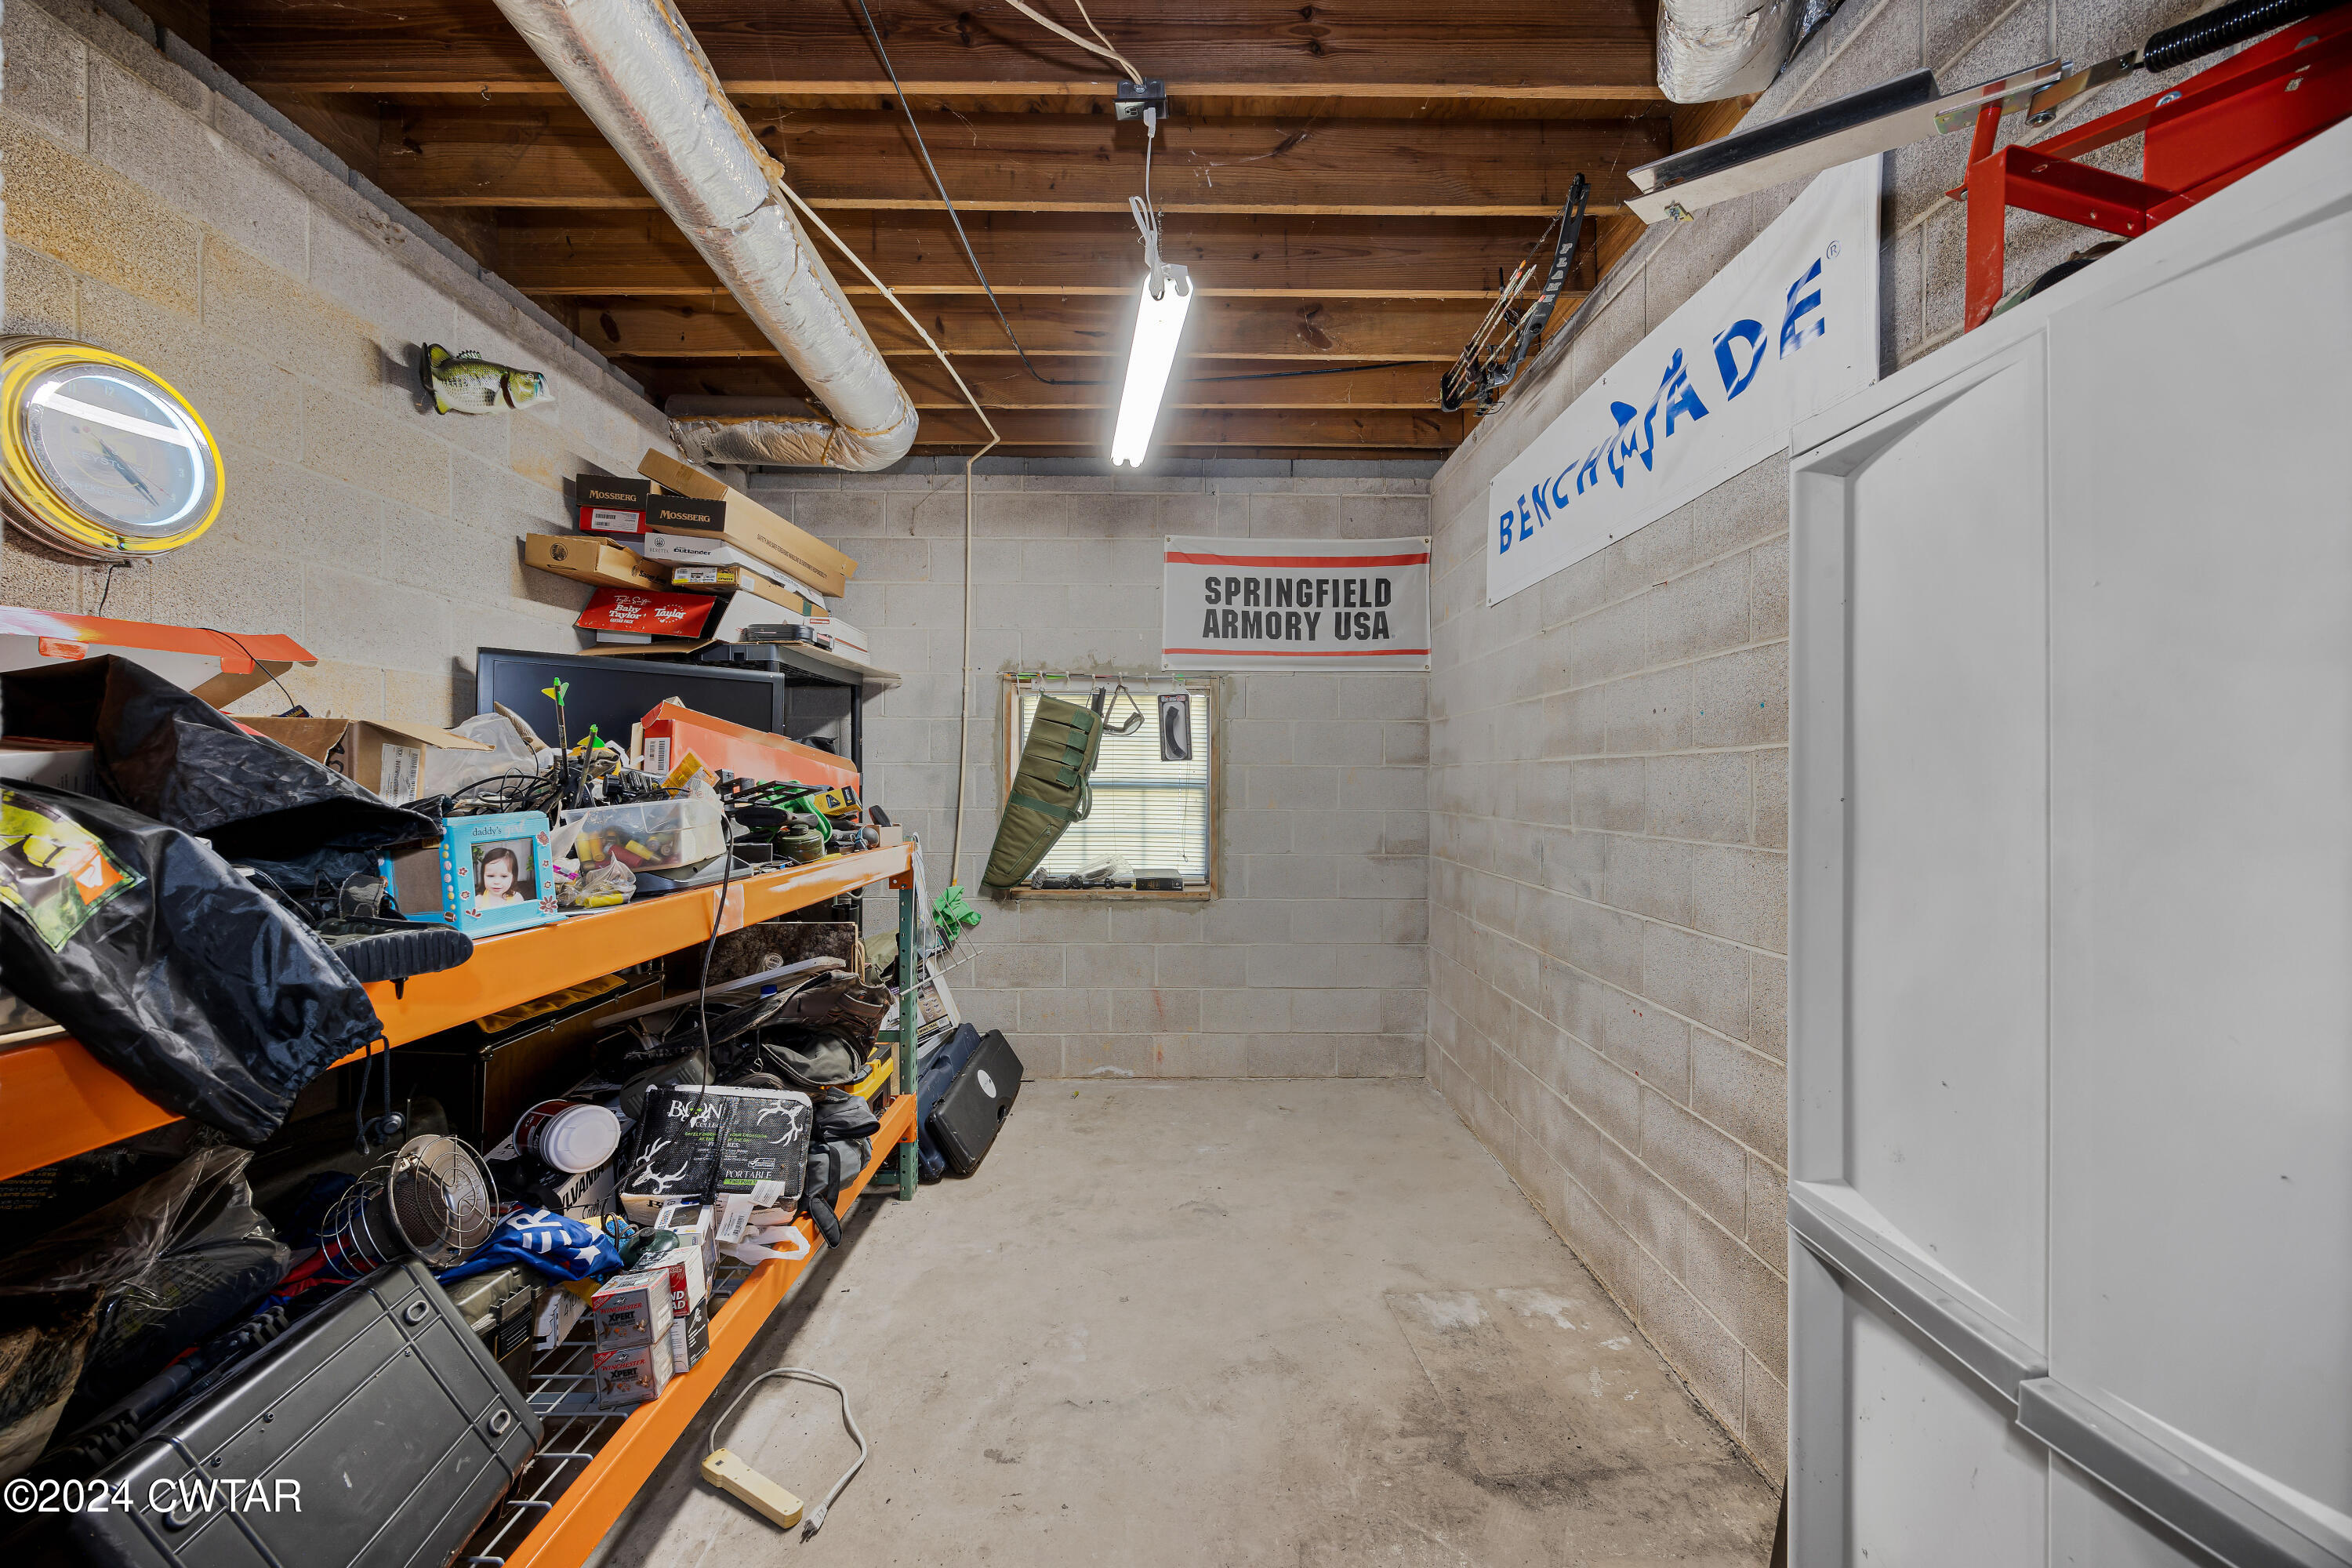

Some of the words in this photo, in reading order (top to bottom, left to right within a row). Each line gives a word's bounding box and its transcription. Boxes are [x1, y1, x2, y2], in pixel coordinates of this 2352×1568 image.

[590, 489, 637, 503] MOSSBERG
[659, 510, 711, 523] MOSSBERG
[1204, 576, 1392, 608] SPRINGFIELD
[608, 610, 642, 619] Taylor
[615, 604, 642, 614] Baby
[654, 608, 687, 620] Taylor
[1203, 608, 1320, 641] ARMORY
[1334, 610, 1390, 641] USA
[472, 826, 502, 837] daddy's
[725, 1170, 772, 1179] PORTABLE
[672, 1290, 685, 1301] ND
[600, 1302, 643, 1315] WINCHESTER
[672, 1300, 686, 1310] AD
[608, 1311, 635, 1322] XPERT
[601, 1359, 646, 1371] WINCHESTER
[610, 1367, 638, 1378] XPERT
